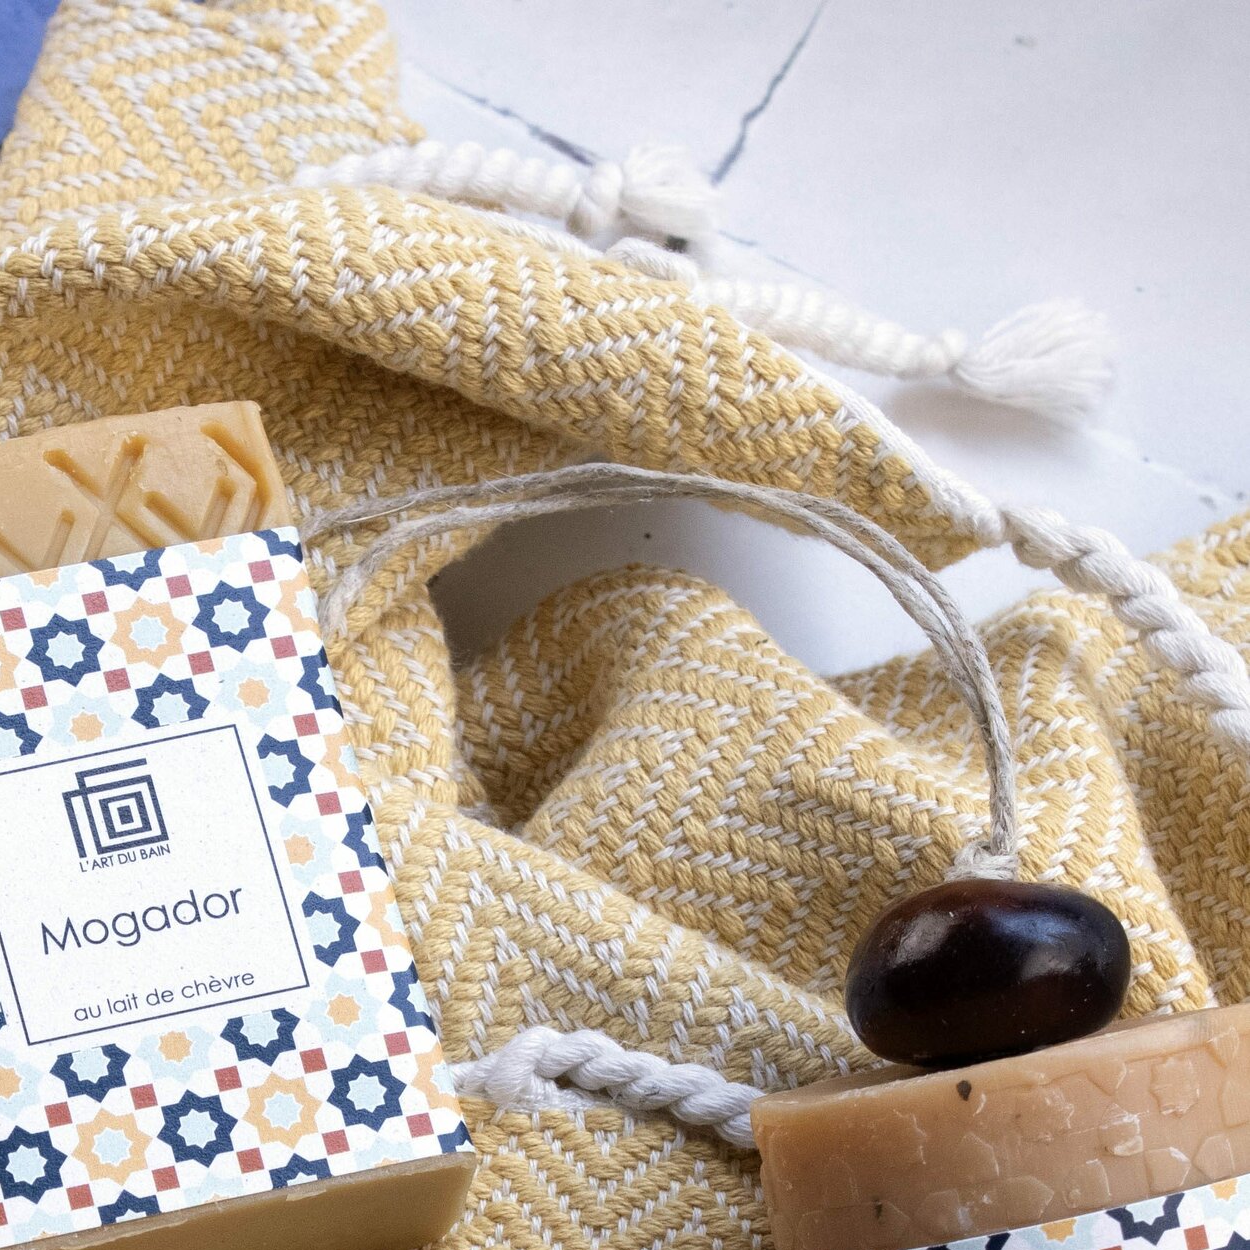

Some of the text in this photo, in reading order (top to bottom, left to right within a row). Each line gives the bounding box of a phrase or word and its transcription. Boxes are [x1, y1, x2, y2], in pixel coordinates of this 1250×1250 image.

[79, 843, 171, 873] L'ART DU BAIN
[40, 887, 242, 956] Mogador
[73, 971, 255, 1022] au lait de chèvre
